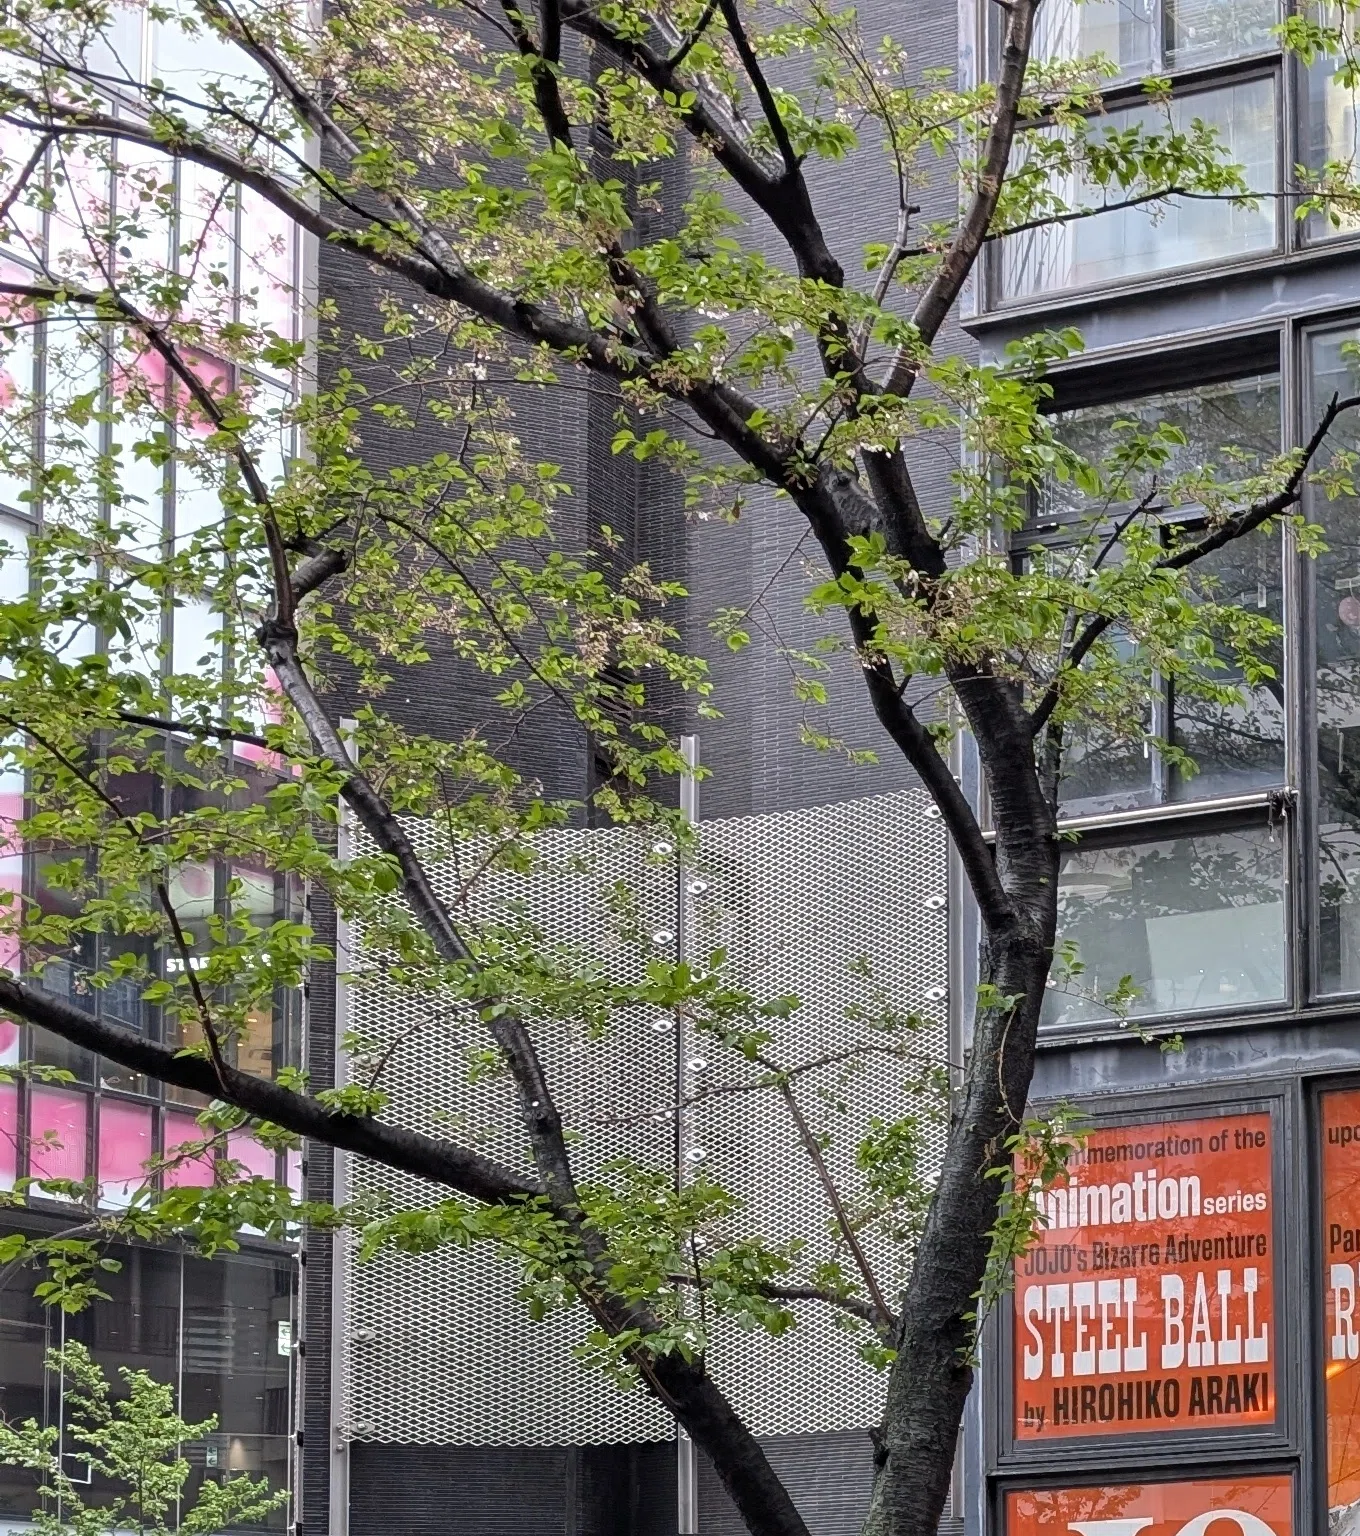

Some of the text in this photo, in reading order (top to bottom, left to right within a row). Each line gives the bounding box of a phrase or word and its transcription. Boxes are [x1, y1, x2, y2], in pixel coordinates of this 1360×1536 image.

[1066, 1133, 1203, 1166] mmemoration
[1208, 1129, 1229, 1152] of
[1233, 1127, 1266, 1150] the
[1027, 1168, 1267, 1231] Animation series
[1024, 1244, 1088, 1277] JOJO's
[1092, 1238, 1160, 1271] Bizarre
[1165, 1231, 1267, 1264] Adventure
[1023, 1277, 1148, 1380] STEEL
[1161, 1267, 1269, 1370] BALL
[1024, 1371, 1269, 1432] by HIROHIKO ARAKI
